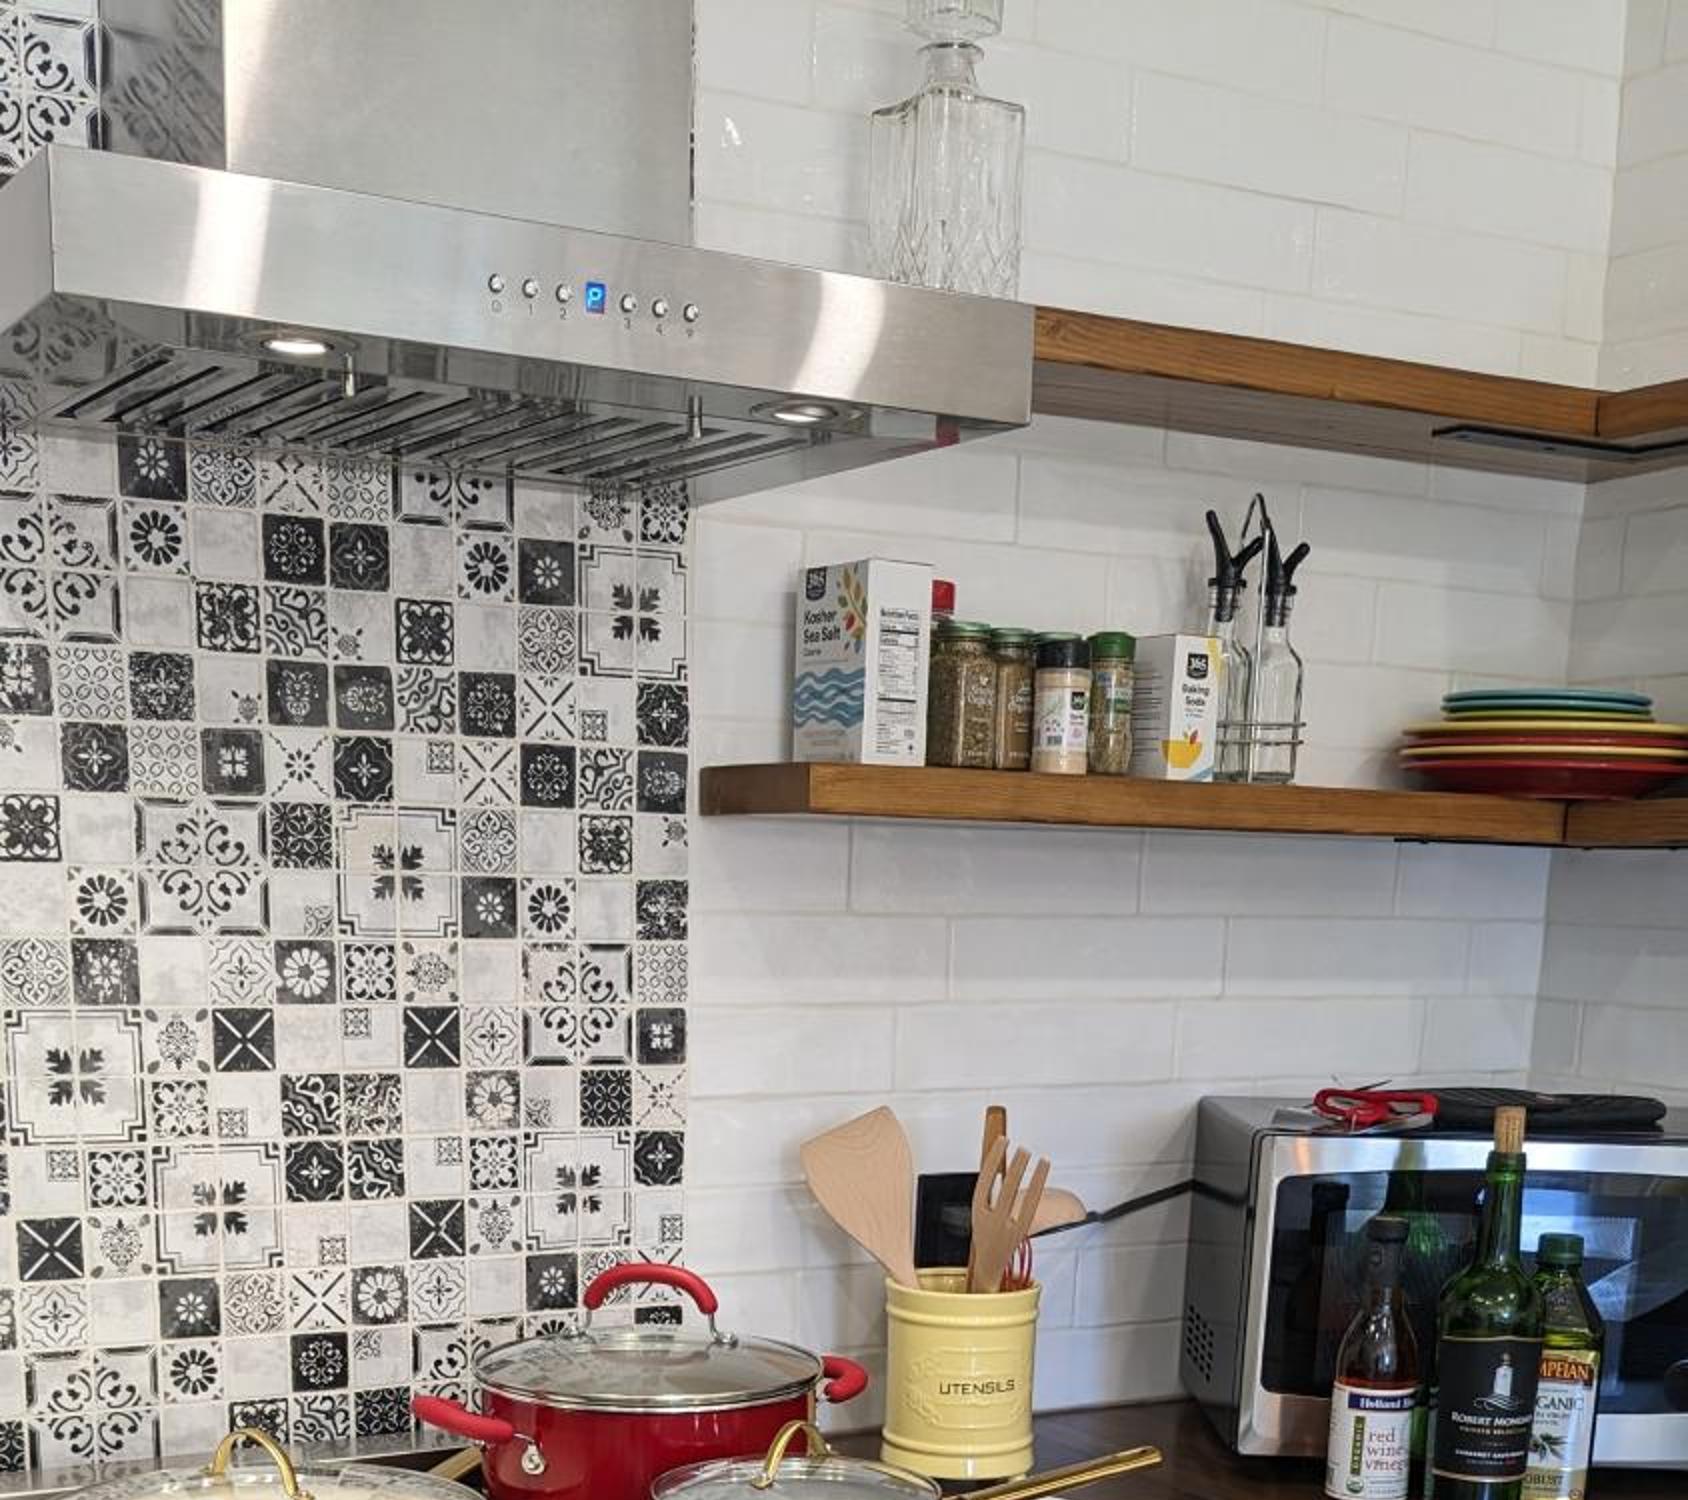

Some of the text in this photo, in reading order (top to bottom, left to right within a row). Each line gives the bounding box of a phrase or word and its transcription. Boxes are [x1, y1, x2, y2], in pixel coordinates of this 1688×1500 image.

[804, 610, 837, 625] Kosher
[804, 626, 841, 644] Sea Salt
[1539, 1360, 1589, 1379] MPEIAN
[939, 1379, 1015, 1395] UTENSILS
[1536, 1396, 1585, 1410] GANIC
[1451, 1411, 1491, 1425] ROBERT
[1369, 1427, 1396, 1442] red
[1367, 1445, 1406, 1457] wine
[1365, 1460, 1406, 1472] vineg
[1524, 1472, 1564, 1485] OBUST
